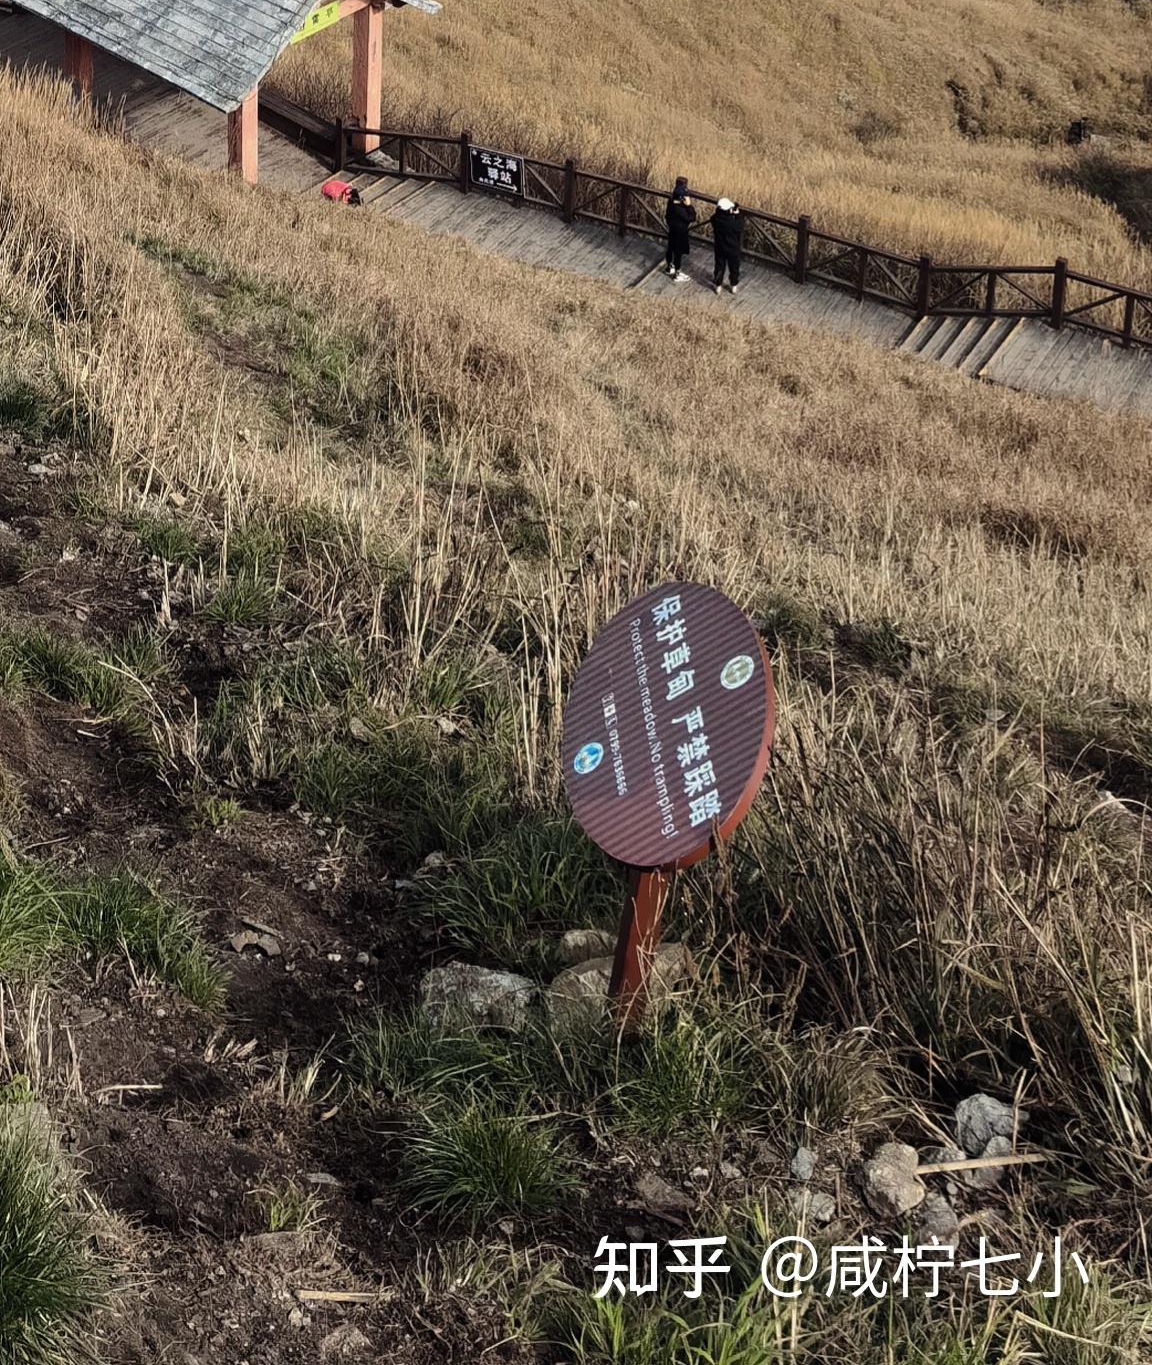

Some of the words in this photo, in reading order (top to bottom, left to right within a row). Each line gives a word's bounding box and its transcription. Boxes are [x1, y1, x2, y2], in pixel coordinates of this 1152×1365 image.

[480, 153, 517, 172] 云之海
[651, 594, 695, 701] 保护草甸
[629, 618, 643, 664] Protect
[636, 665, 649, 685] the
[652, 764, 678, 839] trampling!
[672, 706, 723, 827] 严禁踩踏
